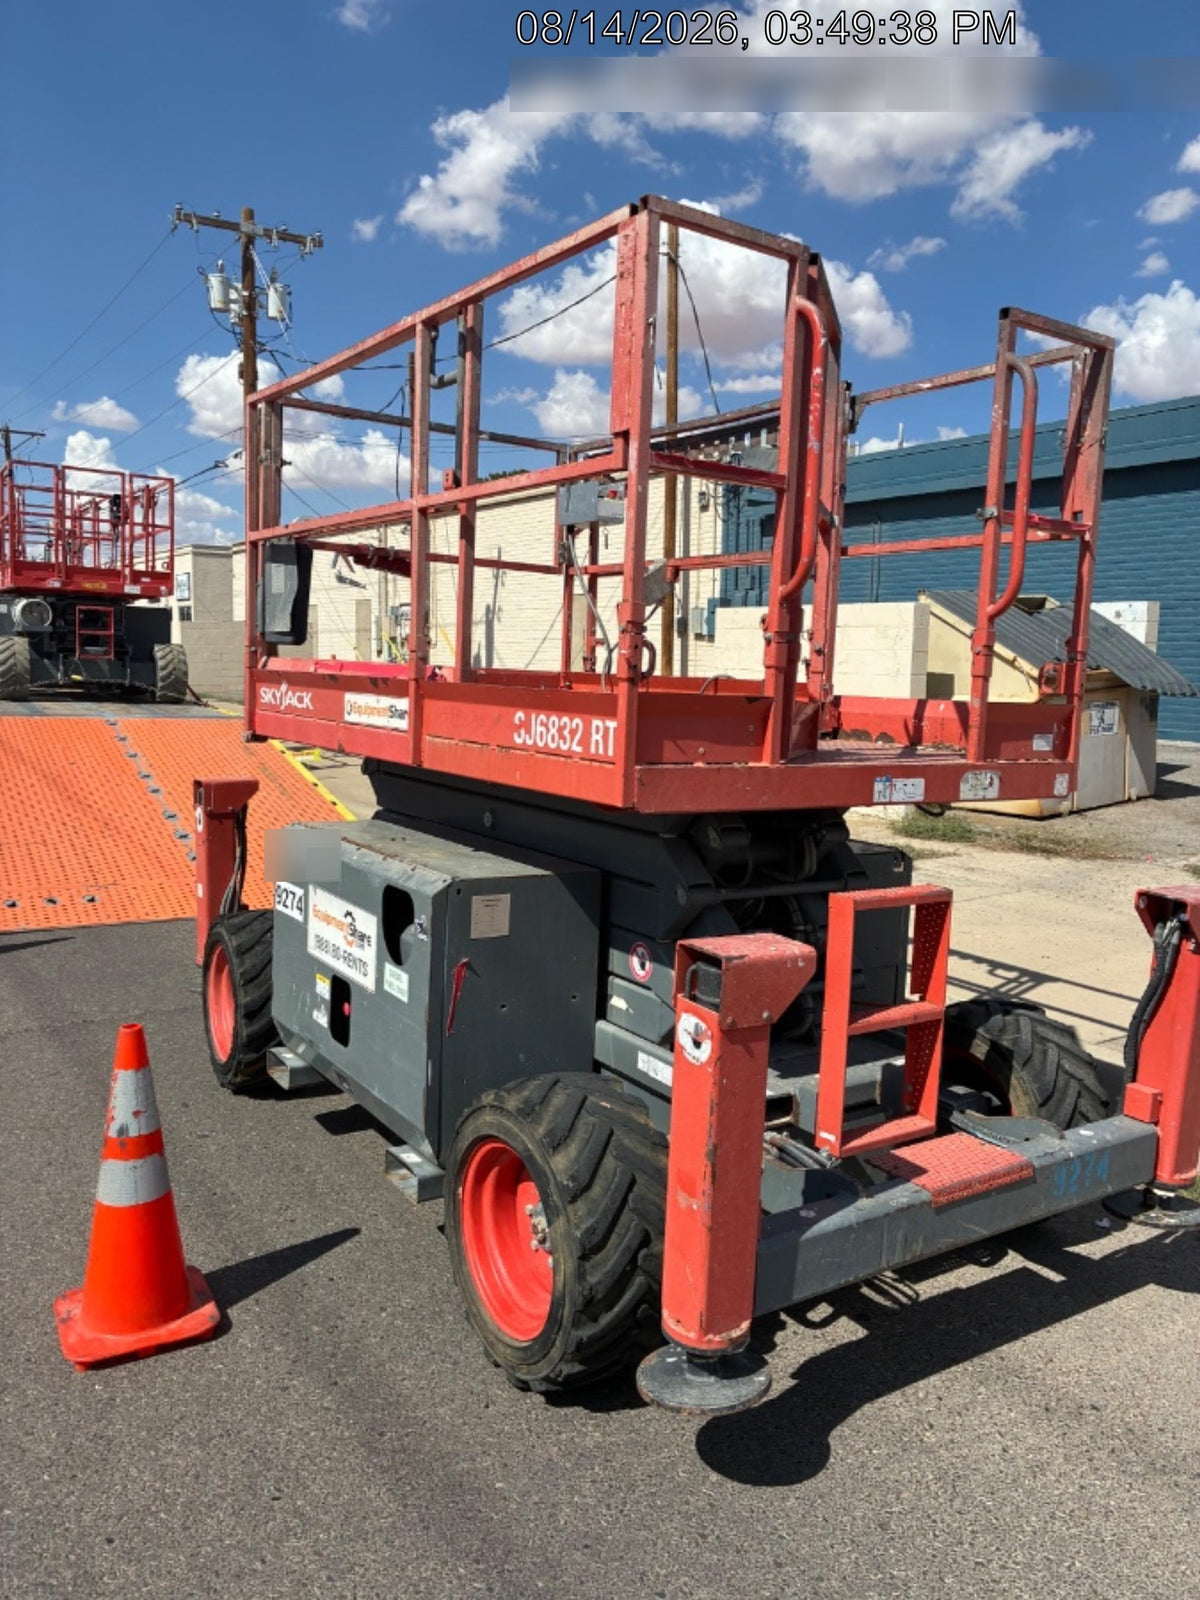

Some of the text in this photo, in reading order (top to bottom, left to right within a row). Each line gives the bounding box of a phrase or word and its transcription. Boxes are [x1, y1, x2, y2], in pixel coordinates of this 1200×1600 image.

[259, 680, 313, 710] SKYJACK
[513, 710, 618, 757] SJ6832 RT
[275, 884, 303, 916] 9274
[1053, 1148, 1111, 1197] 9274
